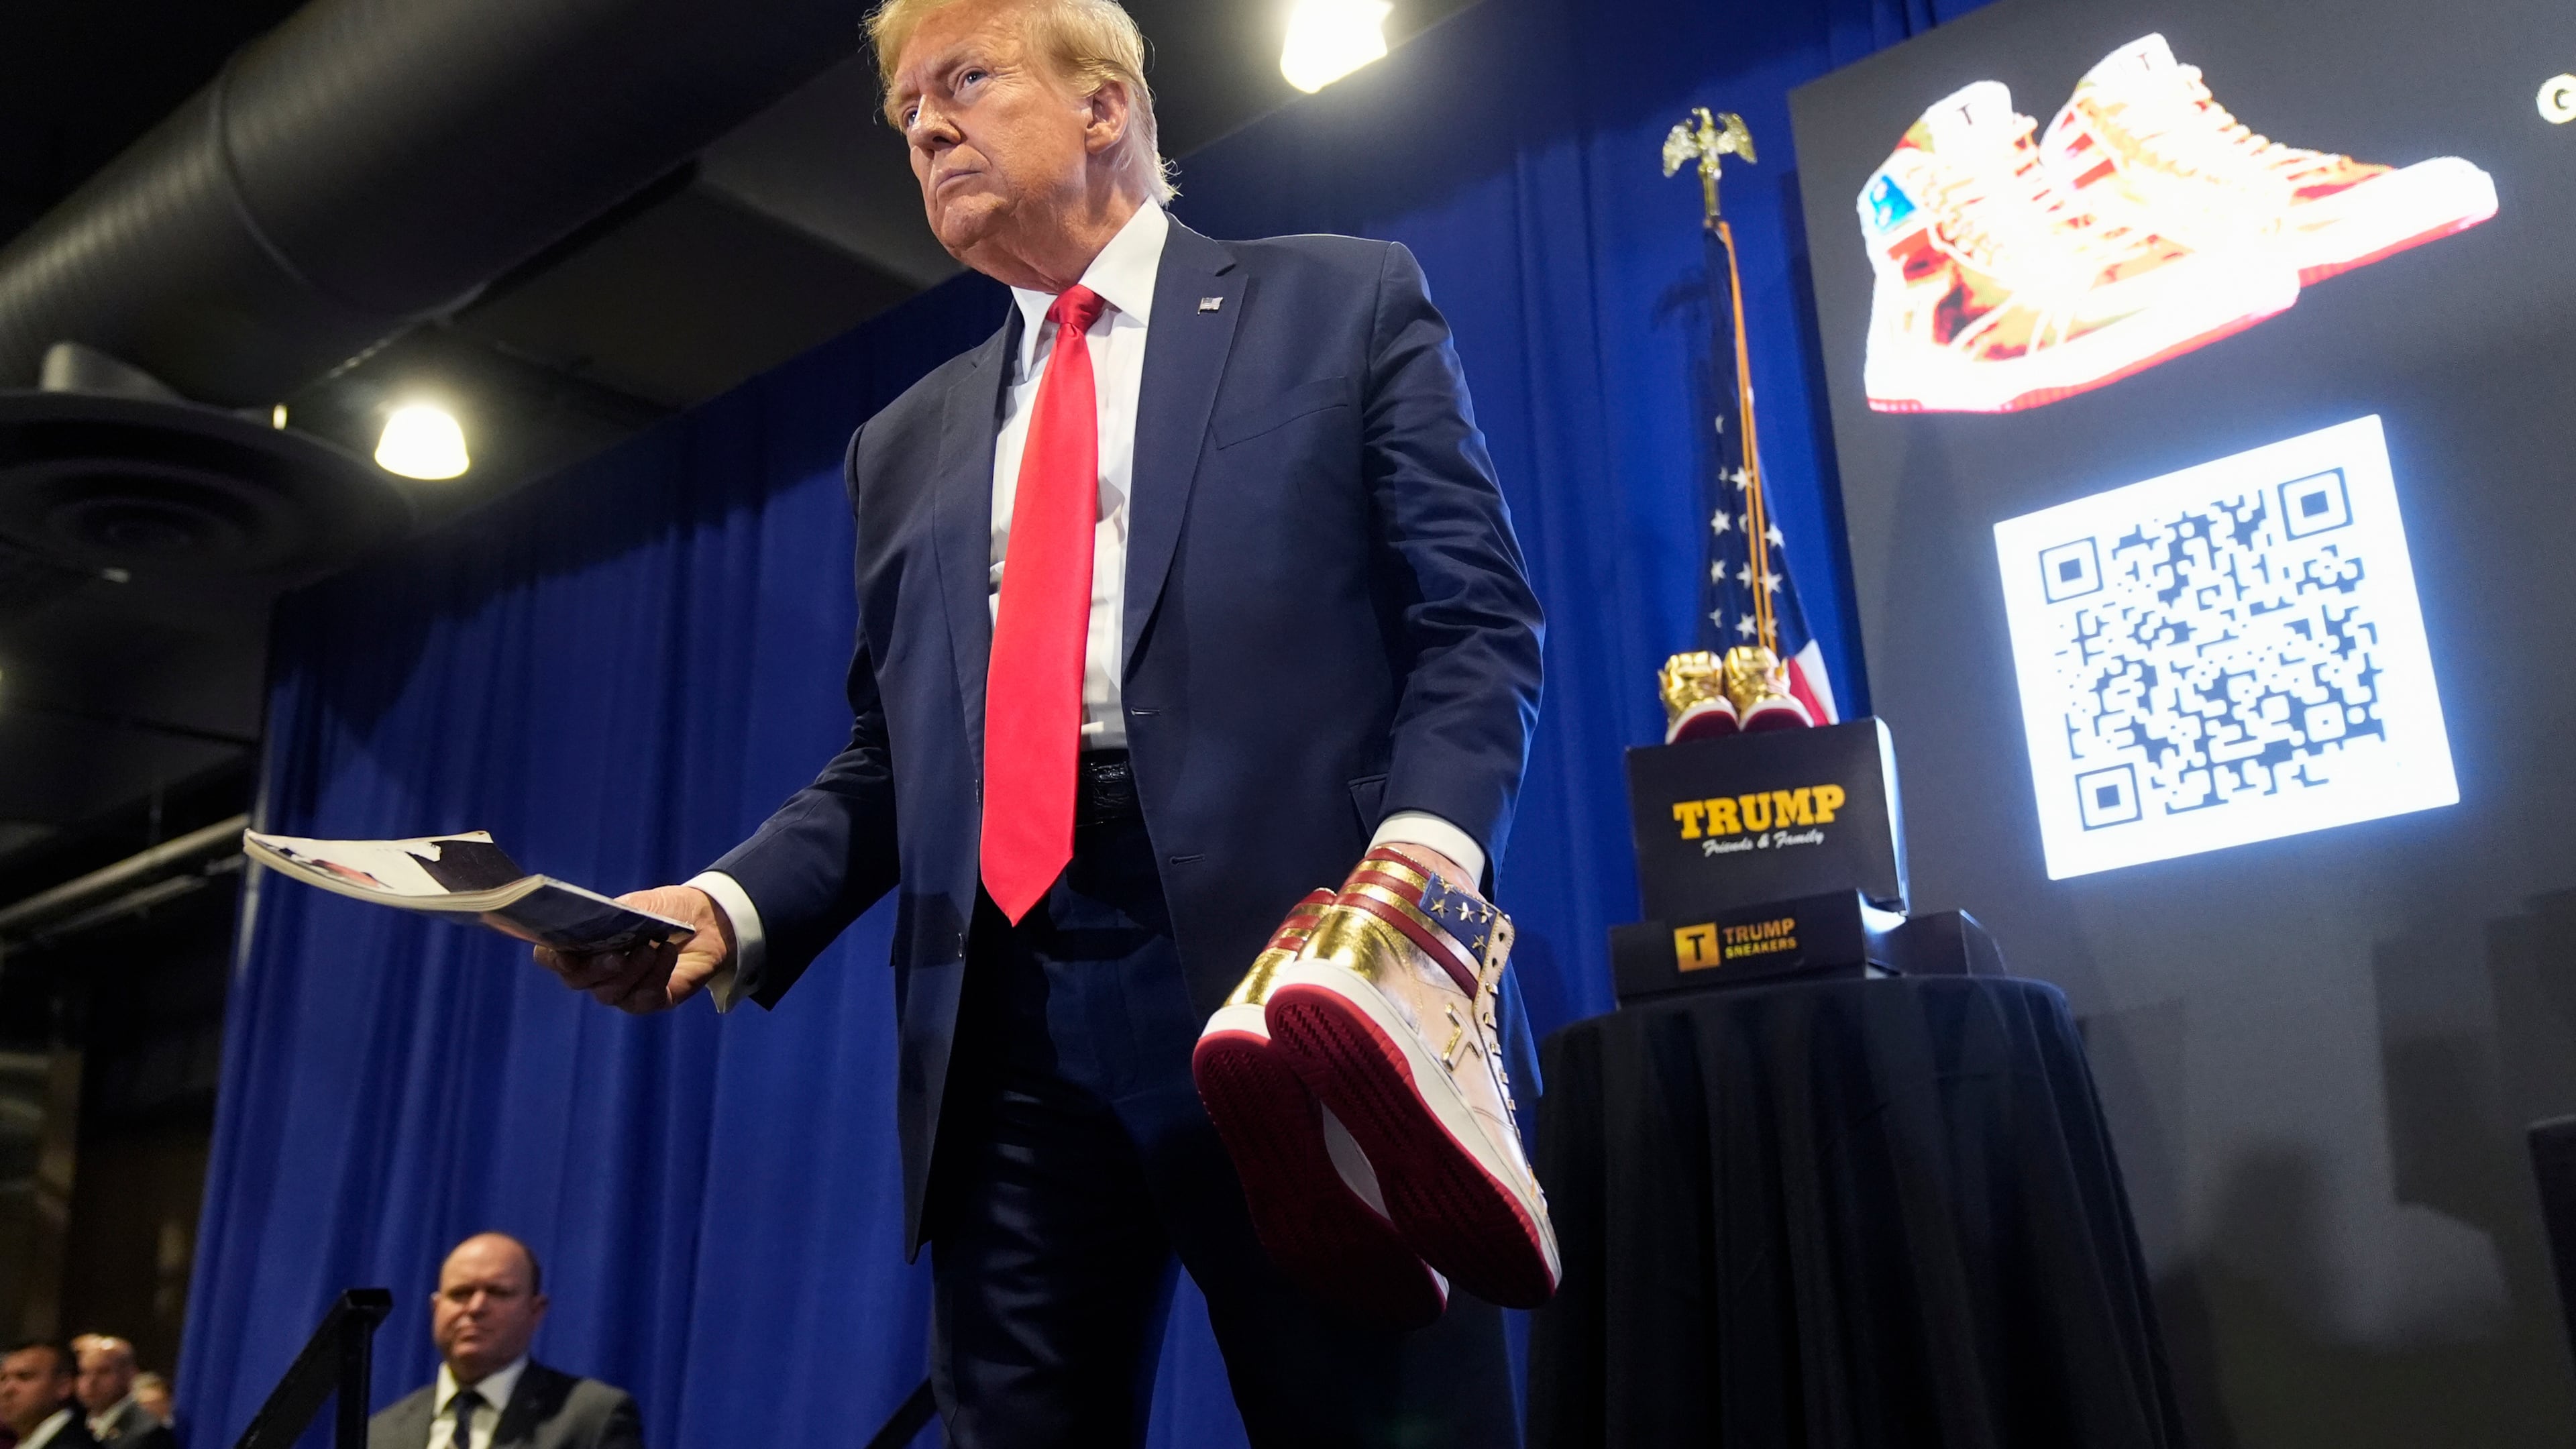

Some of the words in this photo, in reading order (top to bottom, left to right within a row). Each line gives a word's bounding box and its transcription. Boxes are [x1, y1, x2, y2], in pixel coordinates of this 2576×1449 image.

[1955, 103, 1973, 125] T
[1672, 784, 1845, 840] TRUMP
[1702, 837, 1754, 858] Friends
[1756, 833, 1770, 849] &
[1772, 828, 1825, 849] Family
[1723, 917, 1796, 945] TRUMP
[1686, 932, 1706, 962] T
[1725, 936, 1798, 959] SNEAKERS
